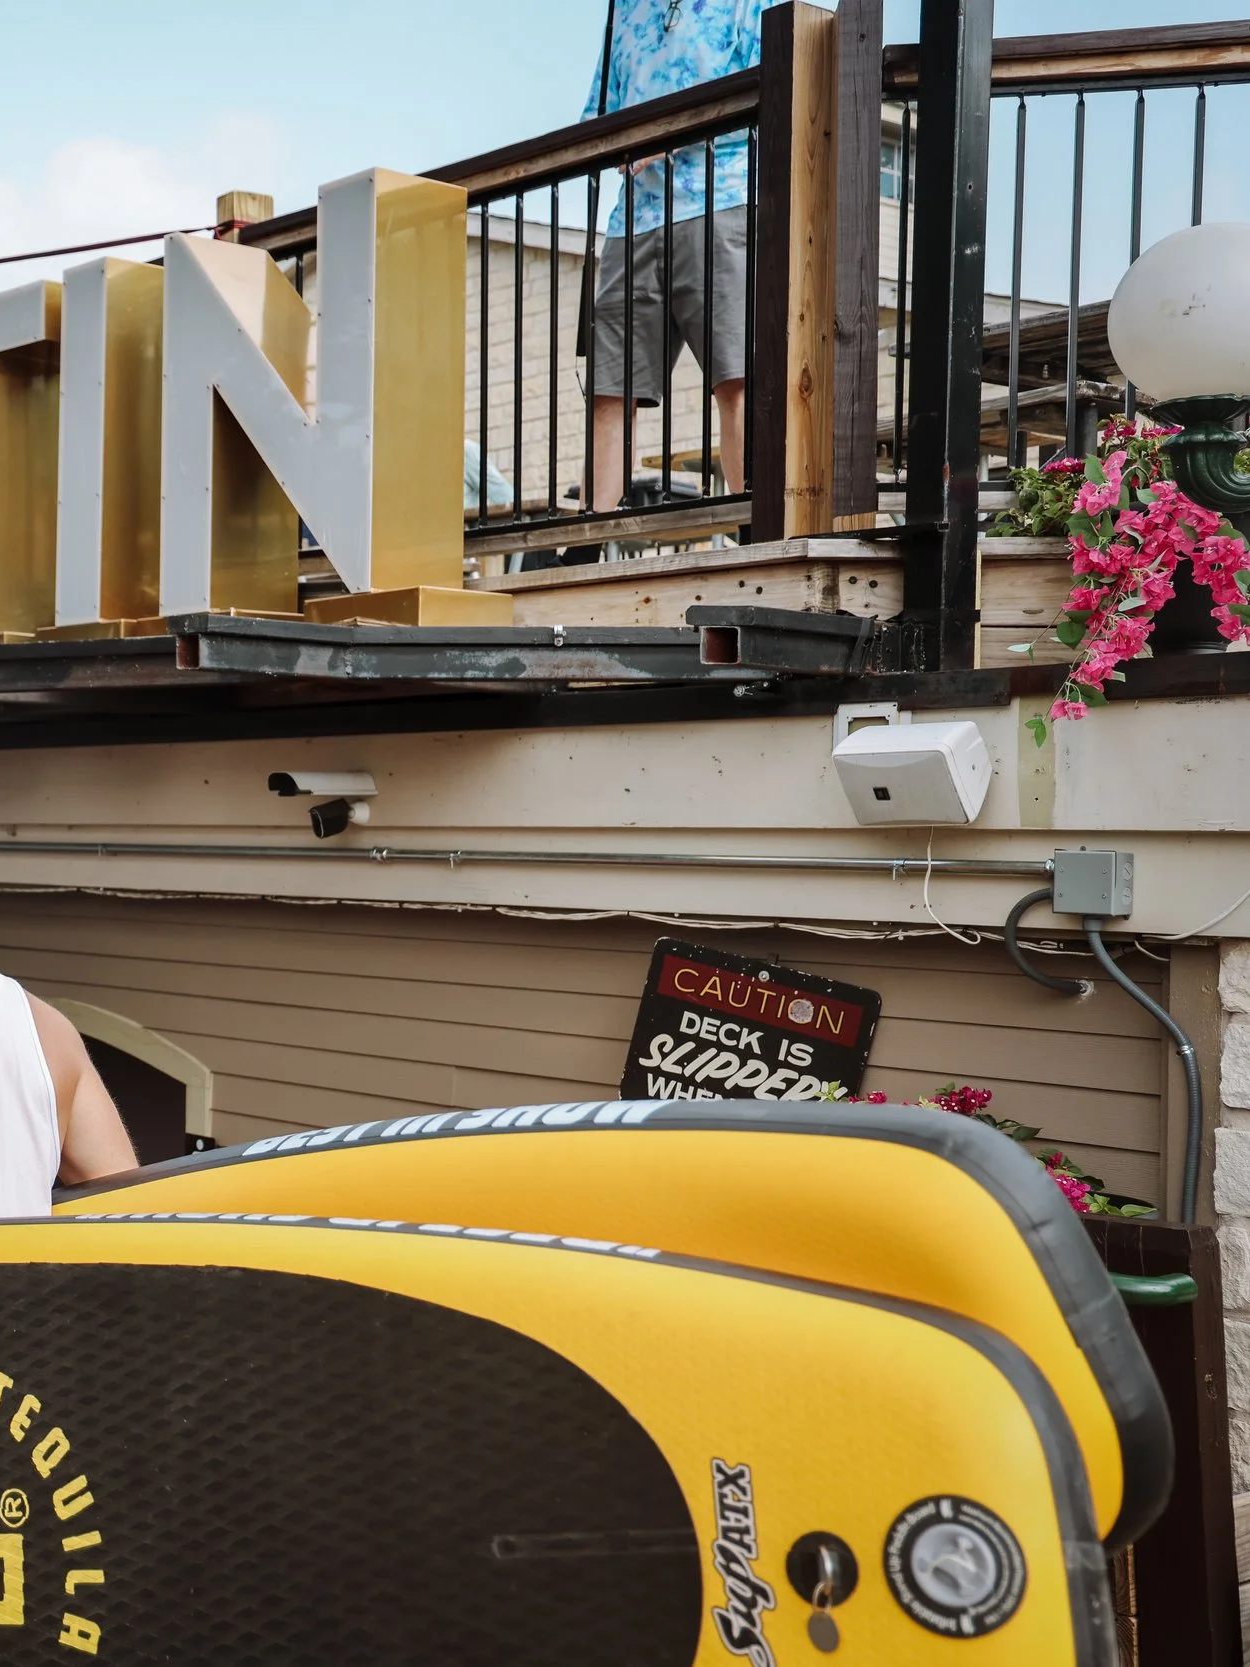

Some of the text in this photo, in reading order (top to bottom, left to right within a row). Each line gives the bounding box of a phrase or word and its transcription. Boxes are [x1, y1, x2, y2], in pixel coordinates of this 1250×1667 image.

[673, 967, 845, 1035] CAUTION
[678, 1010, 815, 1067] DECK IS
[647, 1072, 735, 1101] WHE
